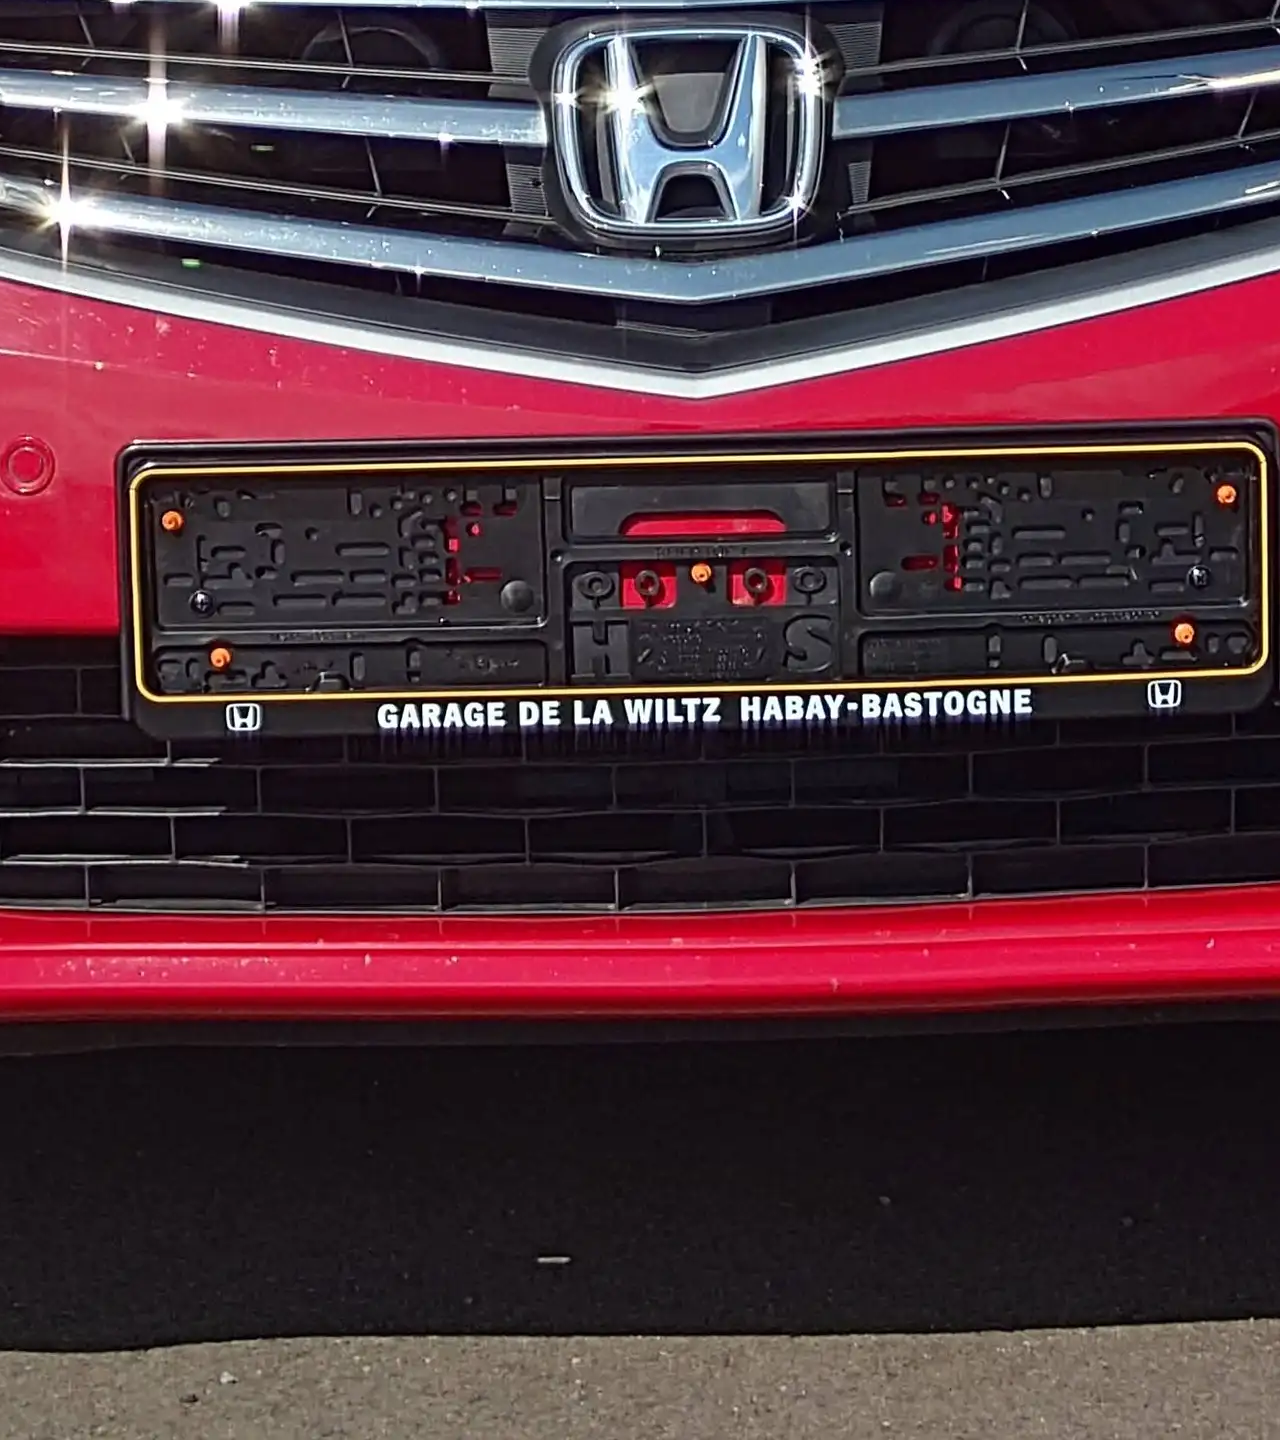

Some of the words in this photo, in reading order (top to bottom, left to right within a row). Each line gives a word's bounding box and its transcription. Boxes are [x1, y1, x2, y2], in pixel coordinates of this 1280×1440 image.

[377, 701, 506, 729] GARAGE
[519, 700, 561, 727] DE
[573, 699, 614, 726] LA
[623, 697, 721, 725] WILTZ
[740, 688, 1033, 723] HABAY-BASTOGNE
